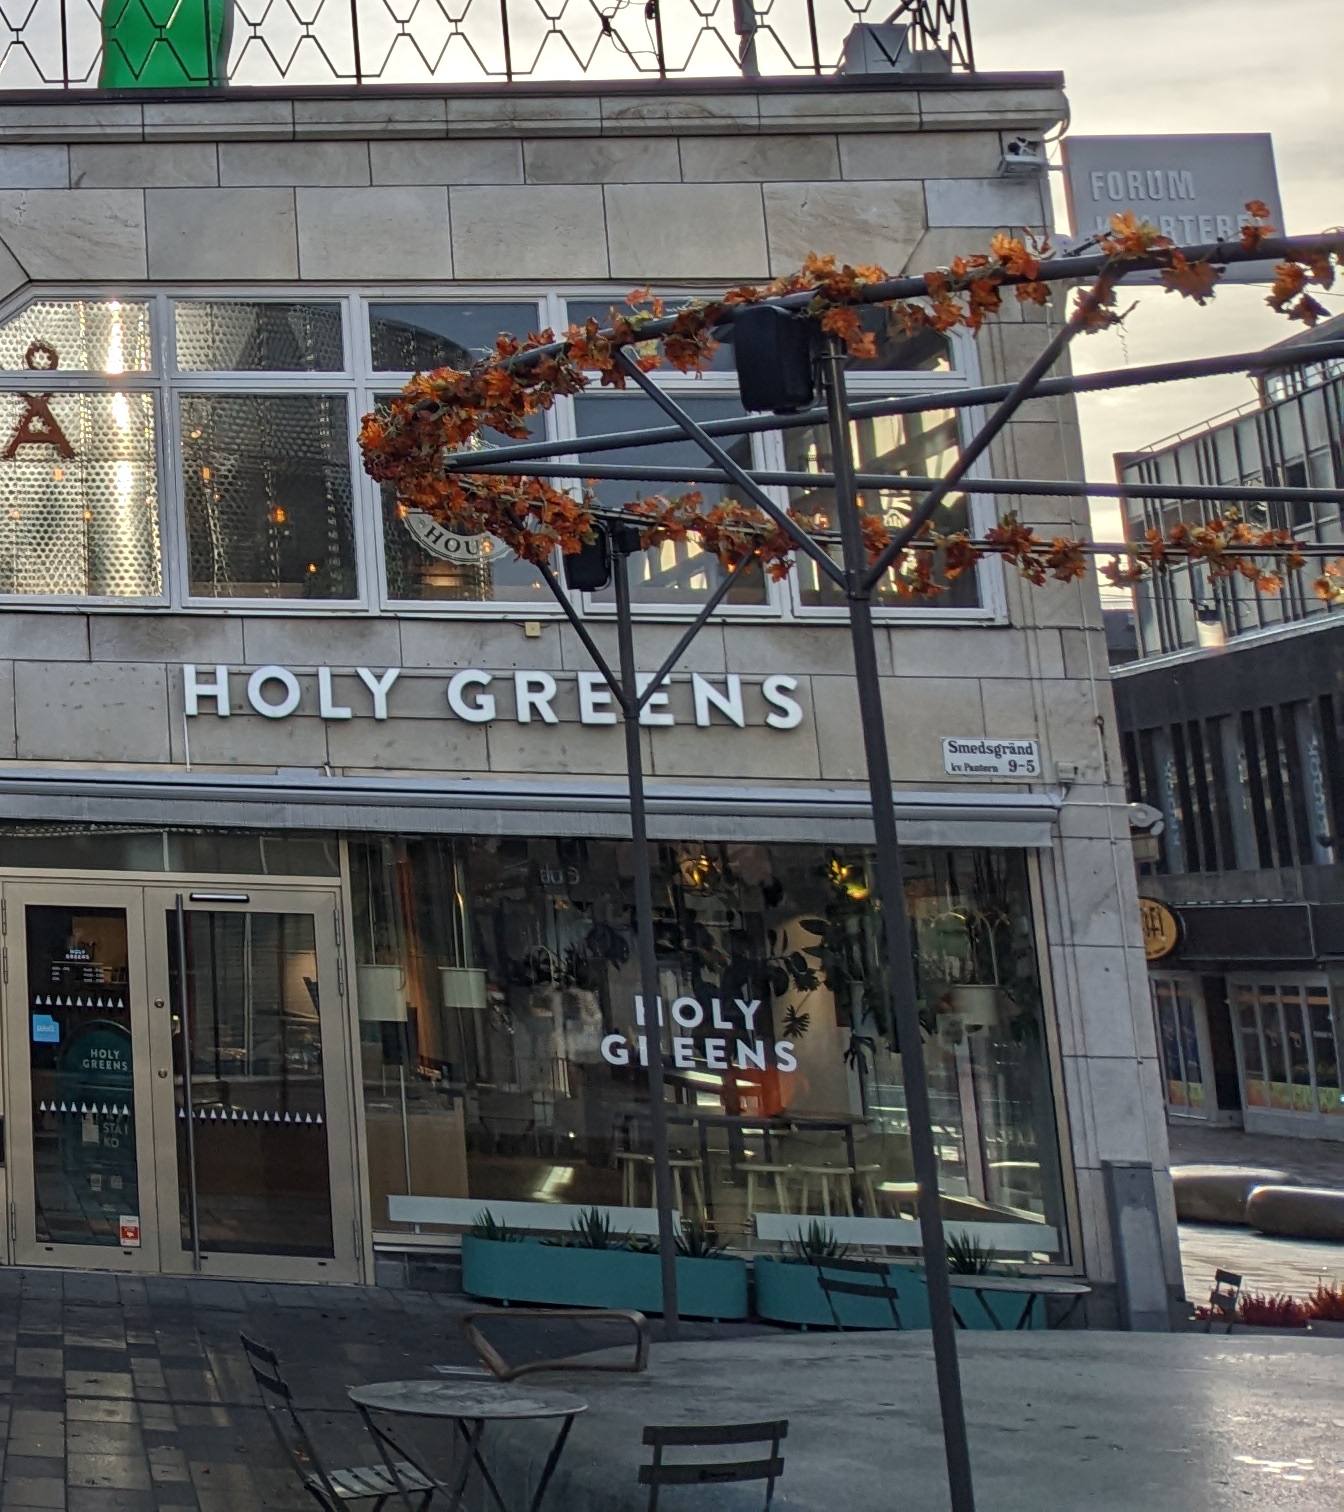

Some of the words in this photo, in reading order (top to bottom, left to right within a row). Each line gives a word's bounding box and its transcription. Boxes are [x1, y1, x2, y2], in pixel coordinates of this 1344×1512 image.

[1091, 170, 1196, 201] FORUM
[182, 664, 402, 721] HOLY
[446, 668, 805, 731] GREENS
[947, 740, 1034, 759] Smedsgränd
[1008, 759, 1036, 774] 9-5
[90, 1048, 120, 1059] HOLY
[82, 1059, 128, 1071] GREENS
